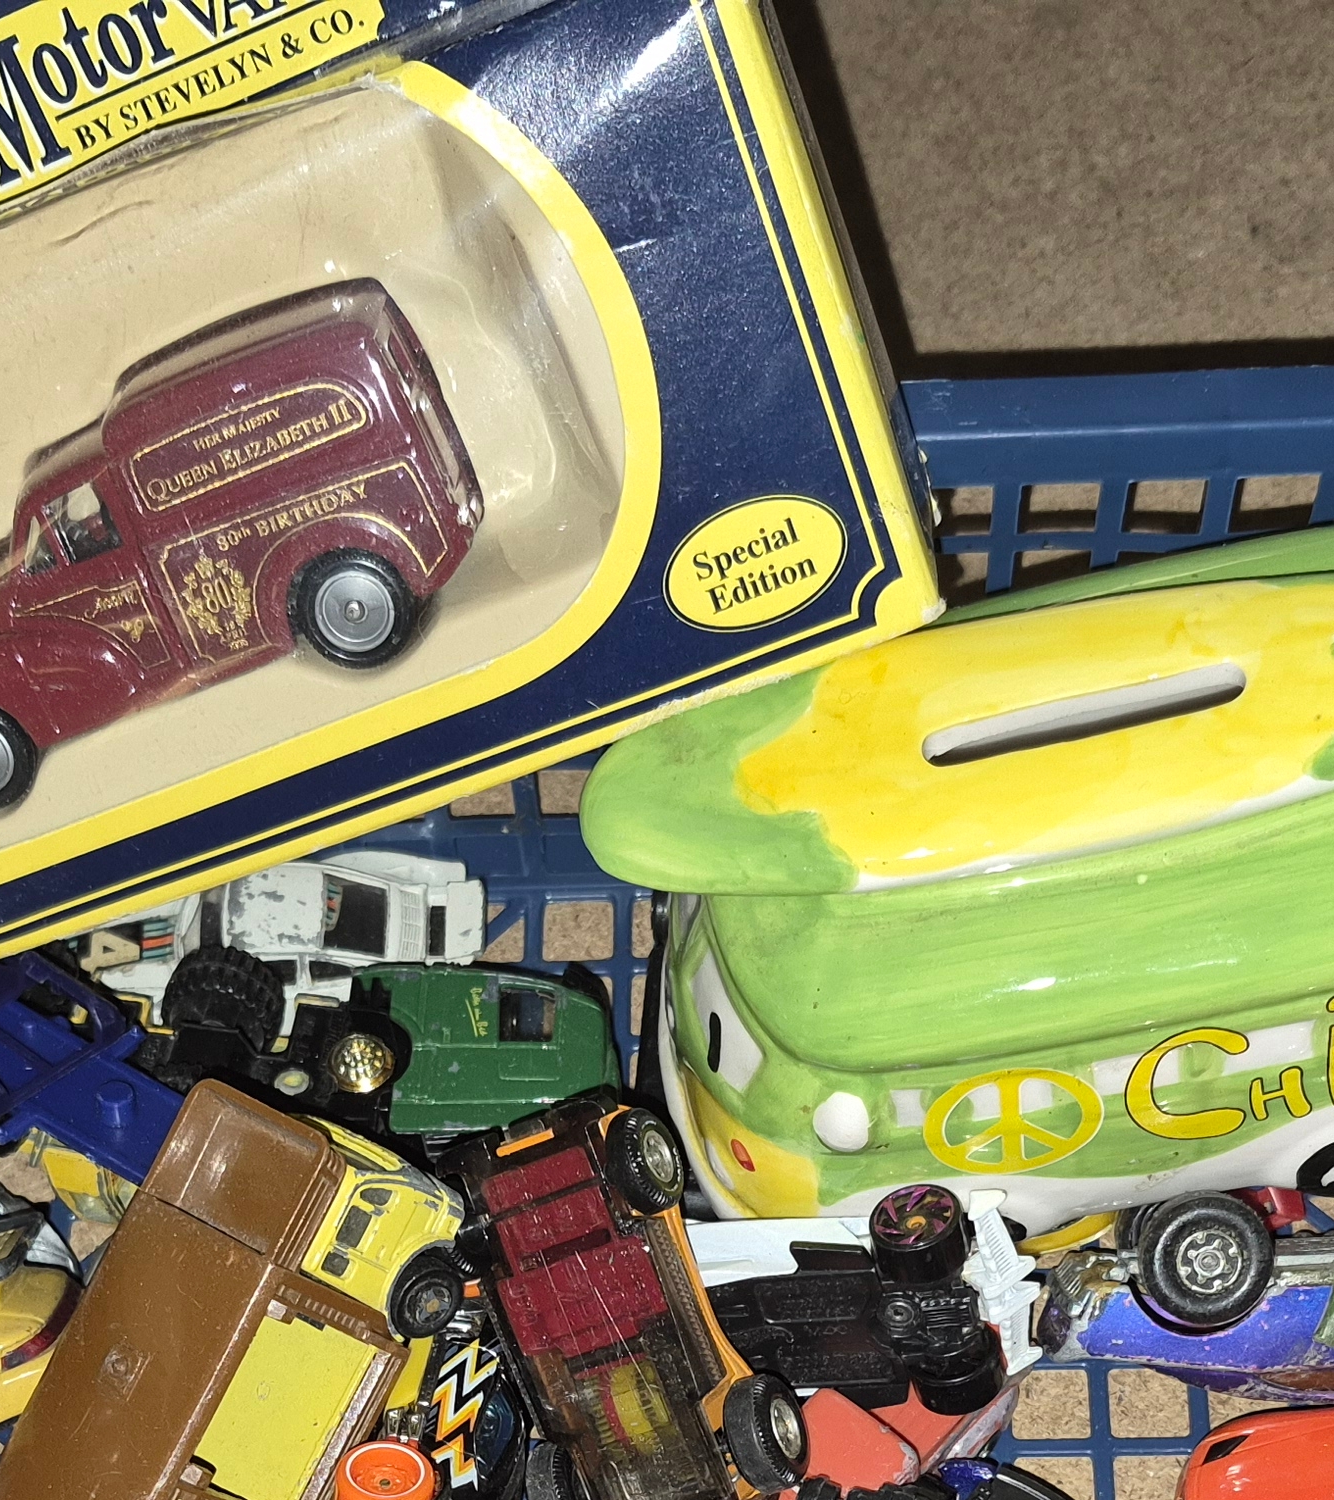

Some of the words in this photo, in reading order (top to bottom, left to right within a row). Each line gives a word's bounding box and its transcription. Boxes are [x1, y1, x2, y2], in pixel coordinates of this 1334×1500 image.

[73, 113, 118, 151] BY
[114, 42, 278, 130] STEVELYN
[275, 29, 305, 62] &
[303, 1, 366, 48] CO.
[144, 458, 220, 502] QUEEN
[217, 415, 333, 470] ELIZABETH
[328, 398, 352, 424] II
[192, 433, 220, 452] HER
[223, 406, 284, 439] MAJESTY
[252, 482, 371, 537] BIRTHDAY
[688, 516, 804, 586] Special
[200, 576, 233, 614] 80
[704, 552, 820, 614] Edition
